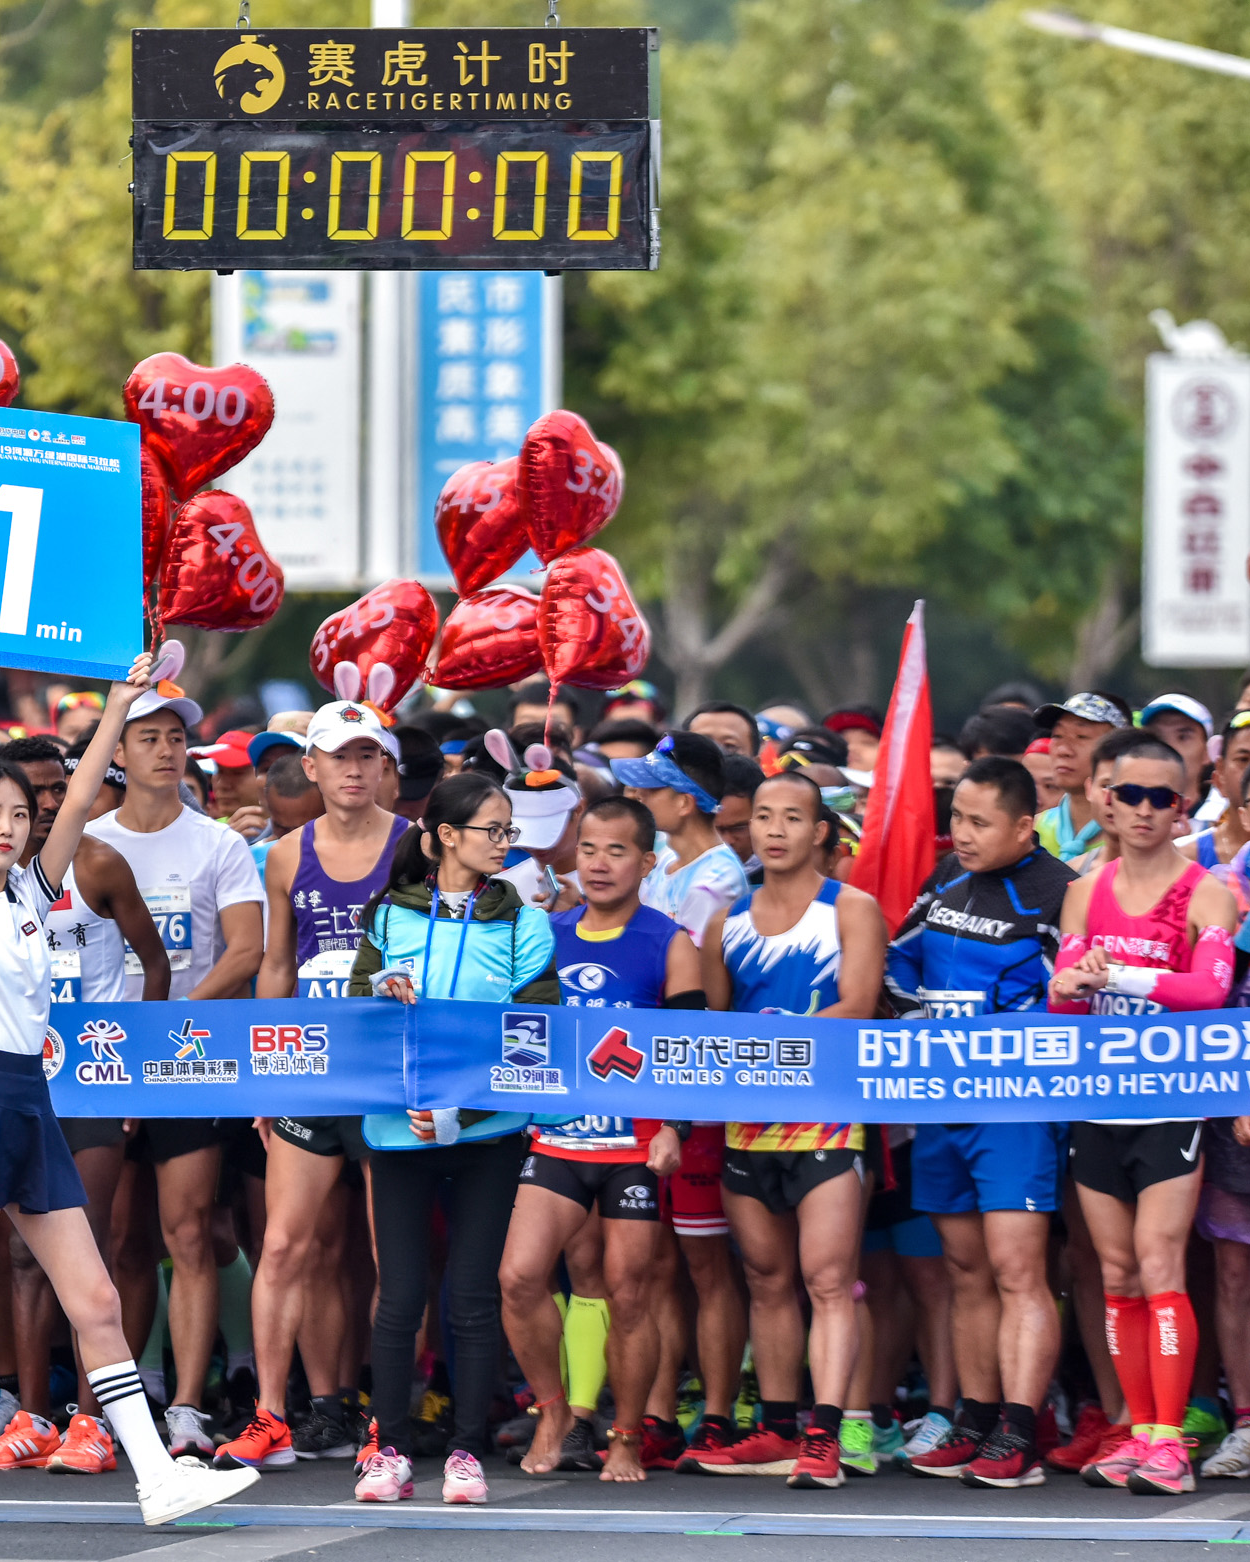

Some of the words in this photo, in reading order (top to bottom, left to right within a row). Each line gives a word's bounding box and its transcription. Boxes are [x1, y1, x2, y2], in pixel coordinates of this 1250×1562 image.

[307, 40, 576, 87] 赛虎计时
[307, 92, 573, 111] RACETIGERTIMING
[162, 151, 623, 240] 00:00:00
[138, 377, 247, 427] 4:00
[207, 521, 279, 614] 4:00
[36, 621, 82, 643] min
[312, 596, 395, 671] 3:45
[584, 572, 650, 674] 3:45
[251, 1025, 327, 1054] BRS
[652, 1035, 814, 1067] 时代中国
[78, 1063, 130, 1083] CML
[144, 1061, 237, 1076] 中国体育彩票
[252, 1054, 328, 1075] 博润体育
[652, 1069, 723, 1086] TIMES
[735, 1070, 812, 1087] CHINA
[857, 1076, 946, 1100] TIMES
[952, 1075, 1044, 1099] CHINA
[1049, 1074, 1113, 1098] 2019
[1118, 1071, 1240, 1096] HEYUAN
